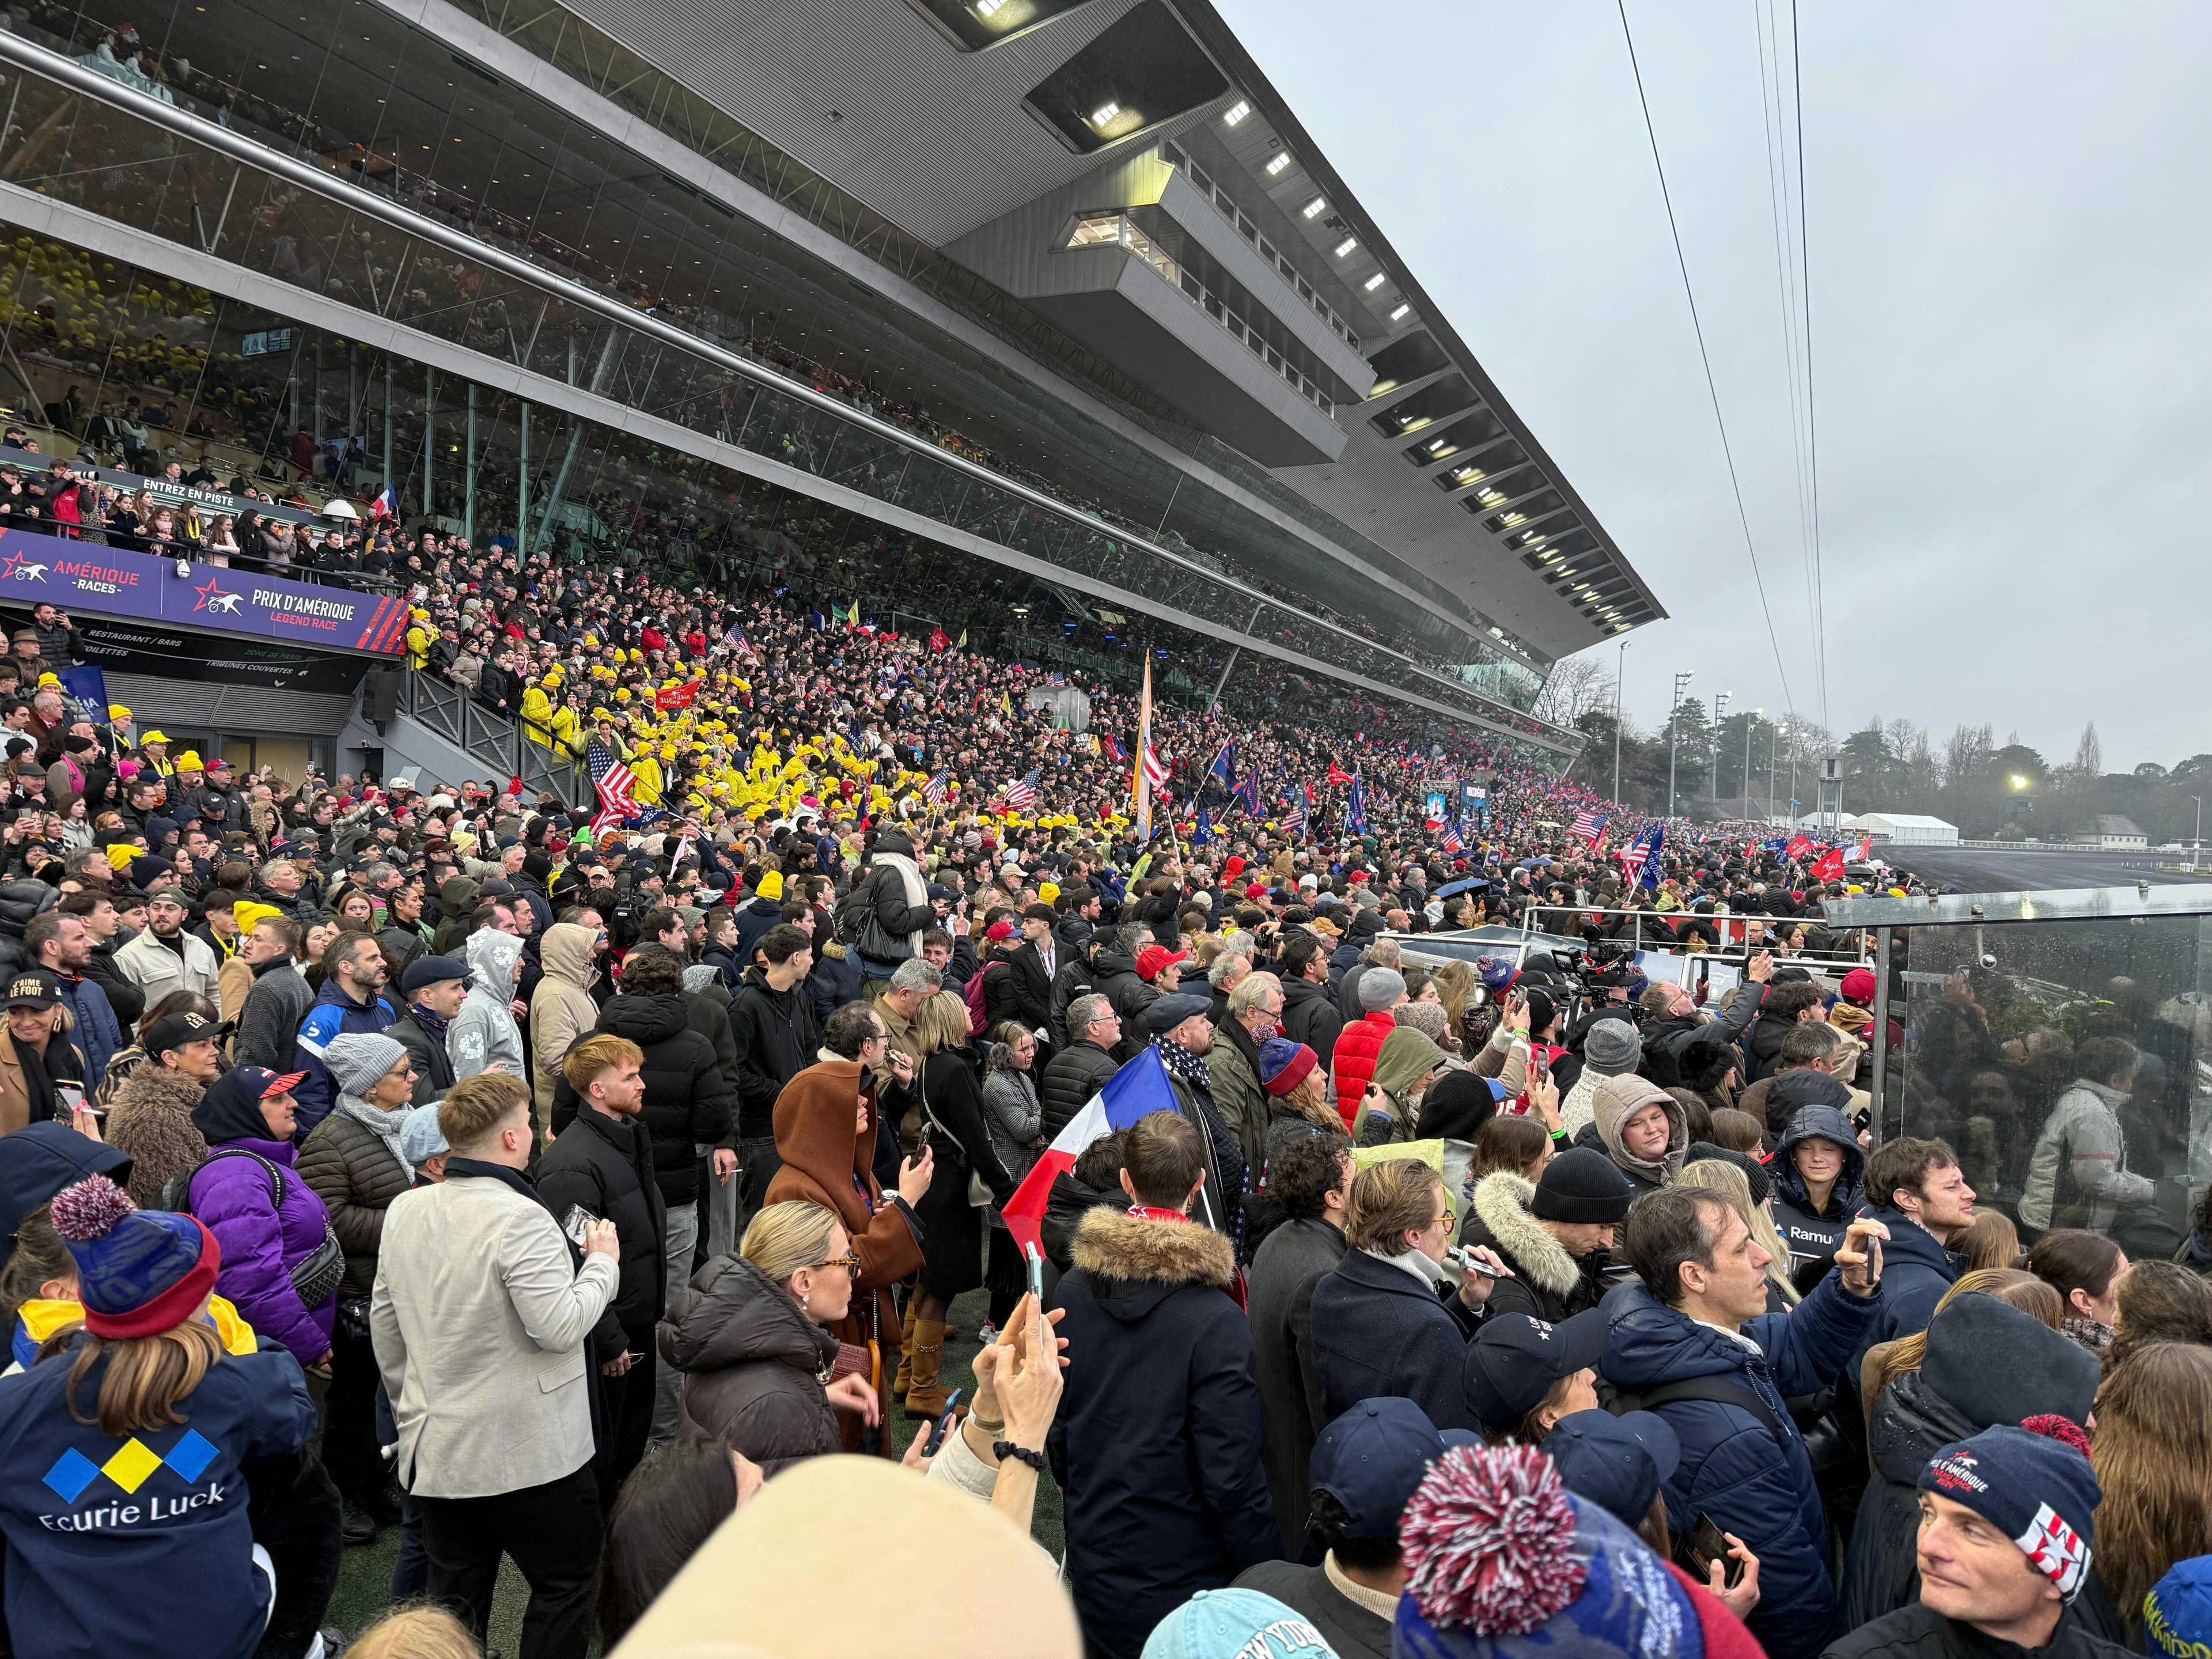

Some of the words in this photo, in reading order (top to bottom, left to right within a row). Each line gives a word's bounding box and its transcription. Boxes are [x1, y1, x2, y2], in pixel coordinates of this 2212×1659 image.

[144, 479, 185, 497] ENTREZ
[188, 488, 202, 499] EN
[204, 493, 234, 506] PISTE
[52, 560, 140, 586] AMÉRIQUE
[252, 589, 283, 609] PRIX
[283, 594, 355, 620] D'AMÉRIQUE
[270, 611, 310, 626] LEGEND
[312, 618, 338, 631] RACE
[88, 630, 151, 643] RESTAURANT
[157, 639, 182, 647] BARS
[244, 649, 266, 657] ZONE
[206, 661, 247, 670] TRIBUNES
[247, 664, 294, 675] COUVERTES
[1603, 961, 1619, 972] RONIN
[10, 987, 20, 998] LE
[20, 986, 44, 997] FOOT
[13, 978, 41, 988] J'AIME
[1790, 1225, 1834, 1245] Ramu
[38, 1499, 141, 1531] Ecurie
[150, 1482, 225, 1521] Luck
